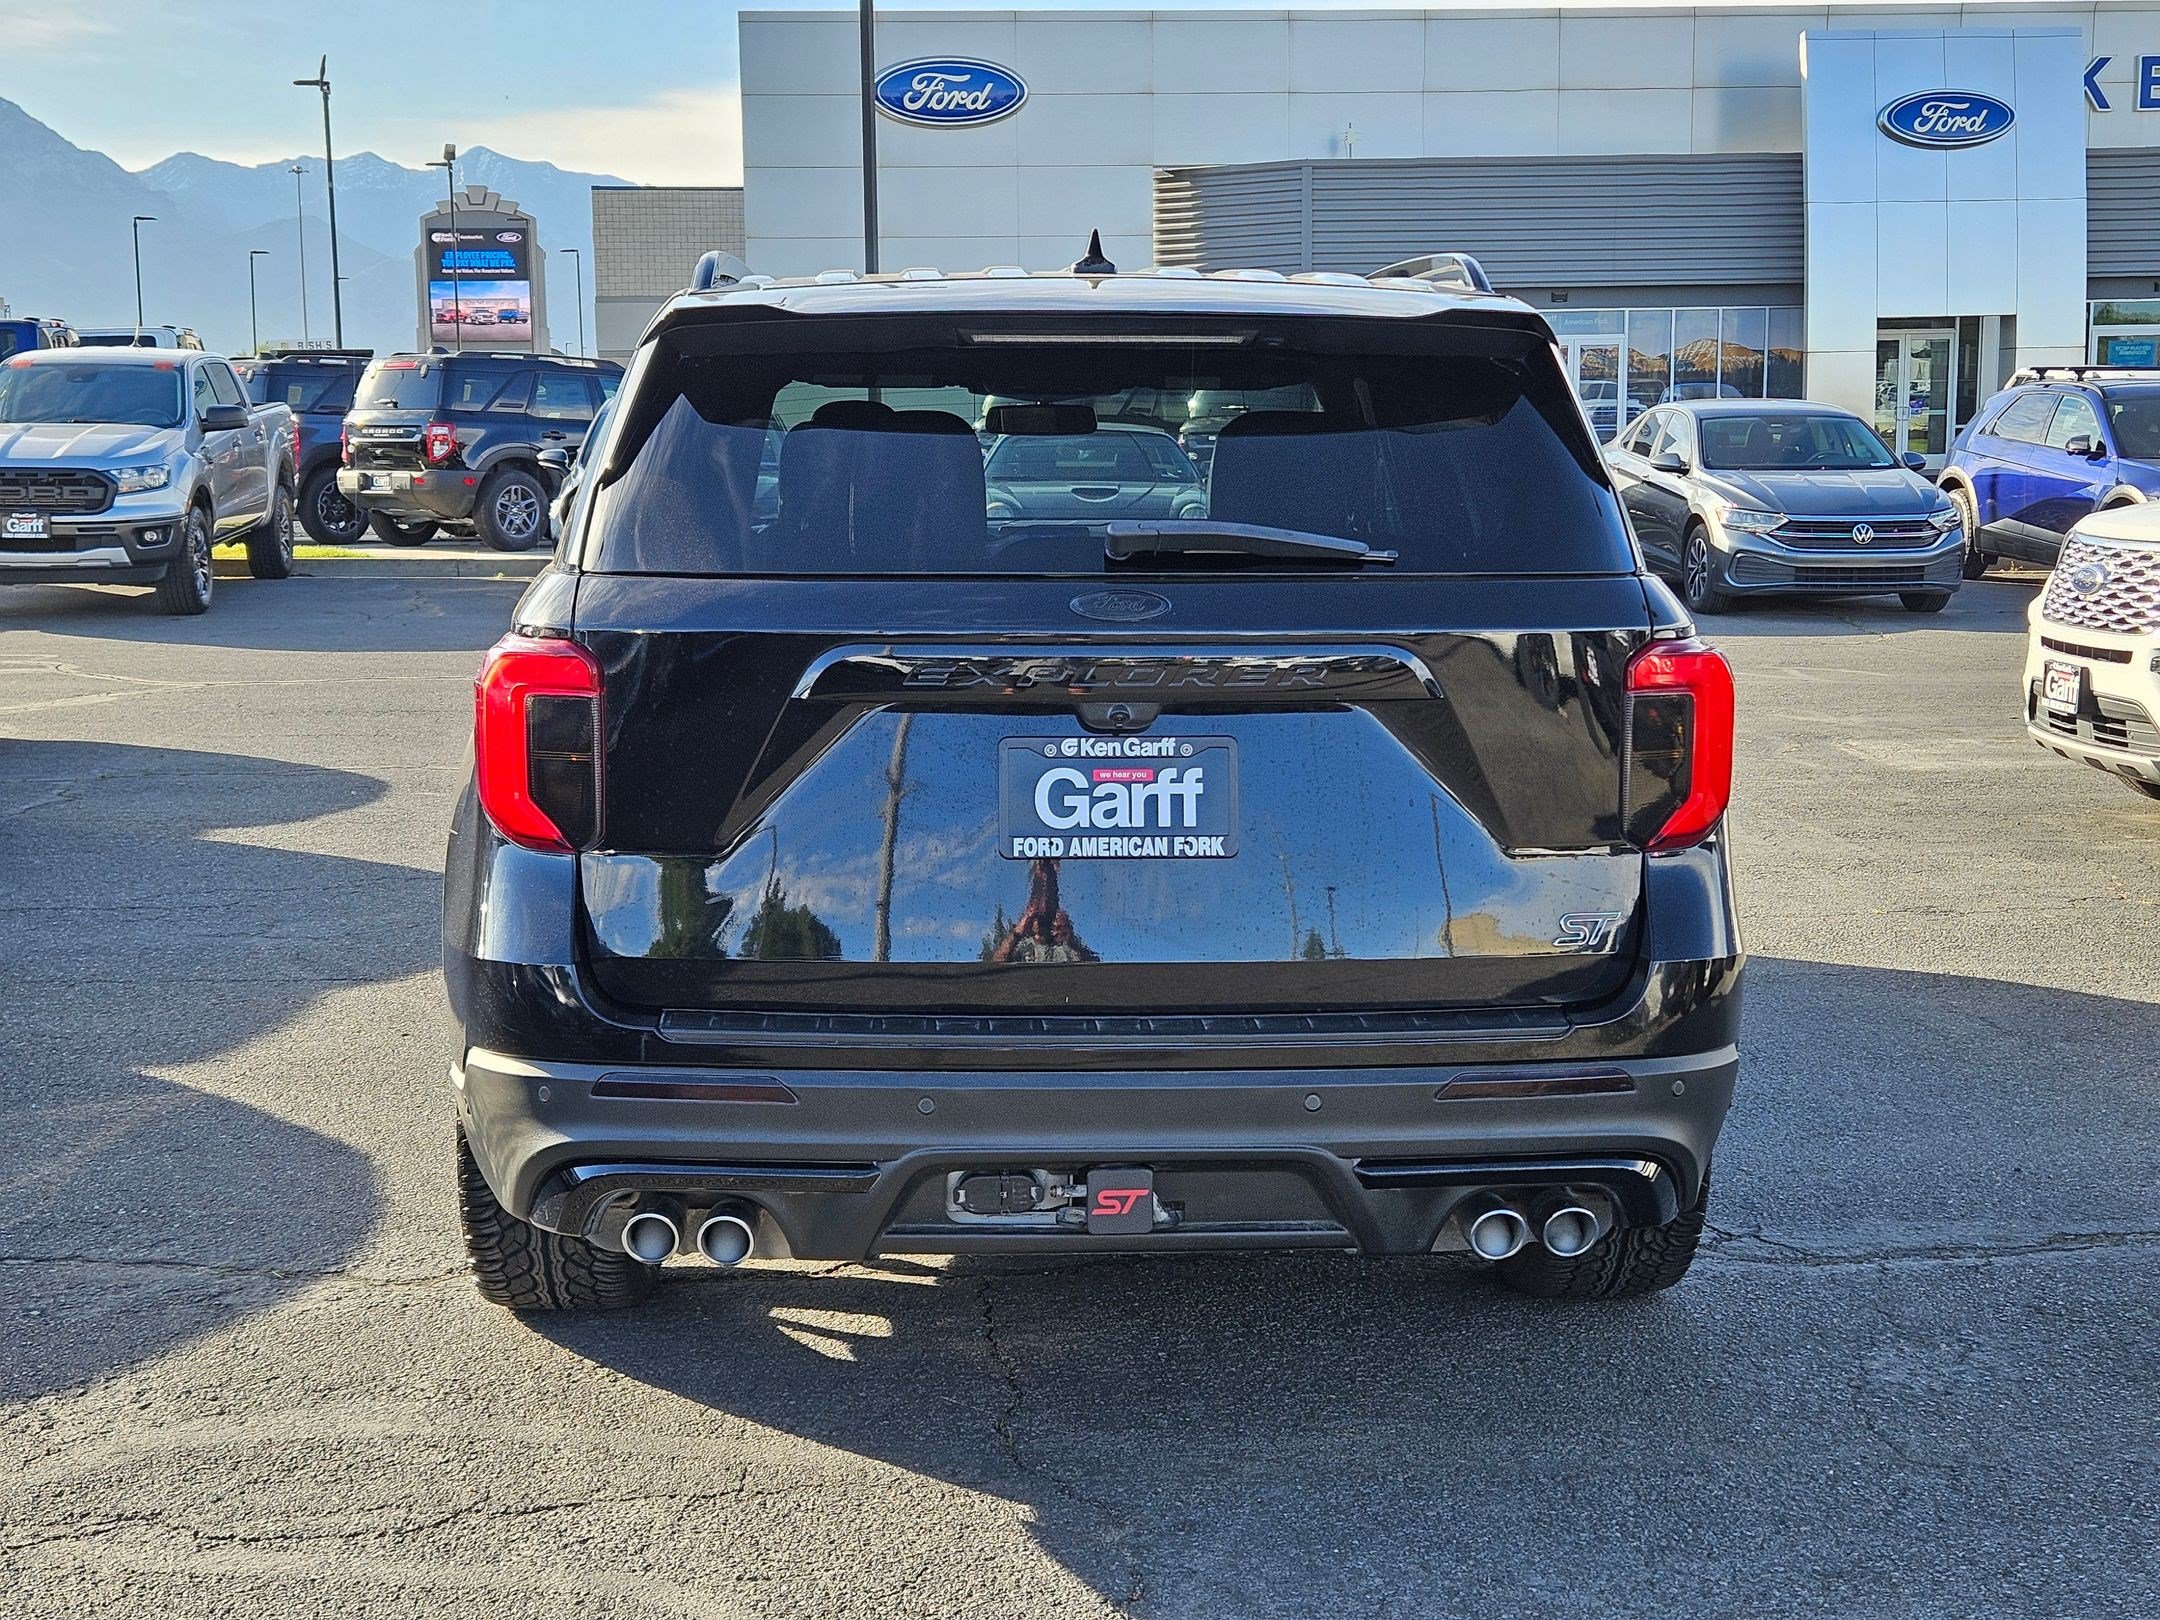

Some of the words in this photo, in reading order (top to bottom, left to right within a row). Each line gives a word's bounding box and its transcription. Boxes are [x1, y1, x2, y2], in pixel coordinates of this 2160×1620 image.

[903, 73, 993, 111] Ford
[1913, 101, 1988, 132] Ford
[6, 518, 44, 532] Garff
[1094, 594, 1146, 611] Ford
[902, 662, 1329, 688] EXPLORER
[1080, 738, 1121, 756] Ken
[1123, 737, 1176, 757] Garff
[1112, 769, 1130, 778] hear
[1131, 771, 1147, 780] you
[1034, 767, 1204, 830] Garff
[1013, 837, 1064, 857] FORD
[1069, 836, 1168, 857] AMERICAN
[1174, 836, 1225, 857] FORK
[1553, 912, 1621, 946] ST
[1091, 1189, 1149, 1216] ST
